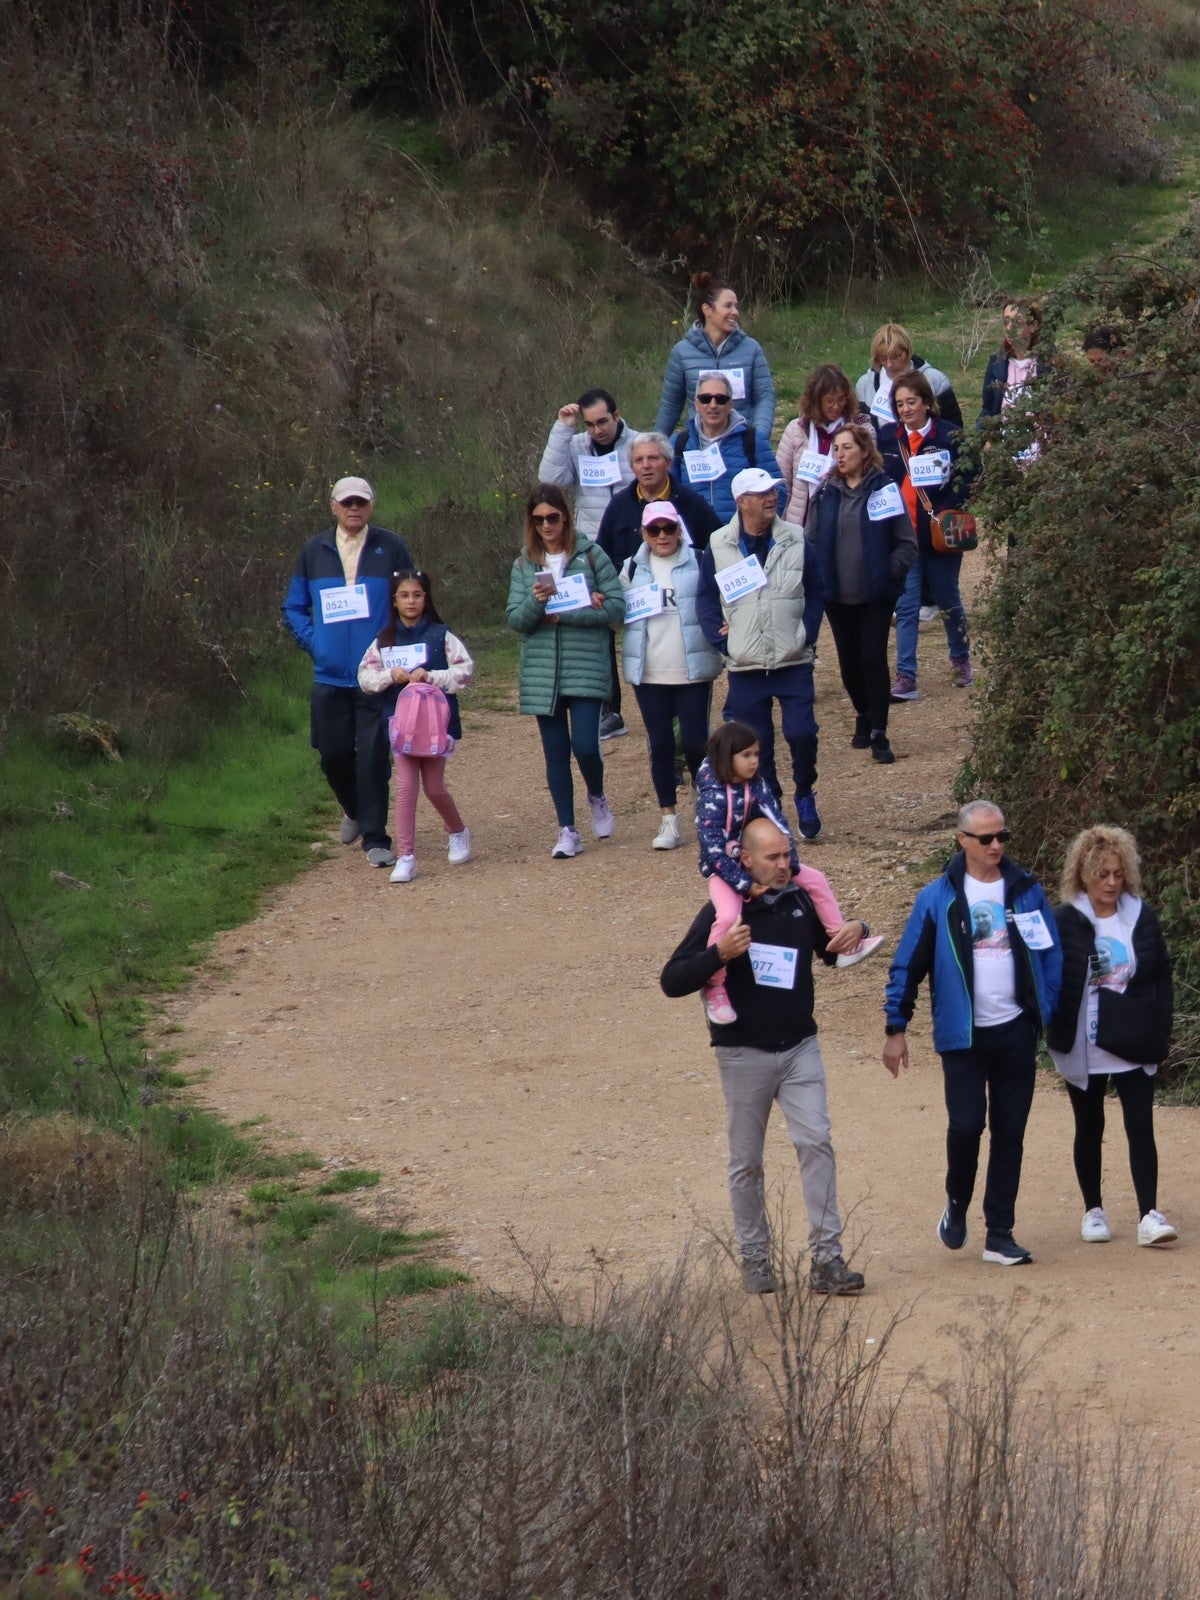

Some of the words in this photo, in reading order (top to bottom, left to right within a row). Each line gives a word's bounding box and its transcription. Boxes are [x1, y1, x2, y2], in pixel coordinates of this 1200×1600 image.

[690, 463, 711, 472] 0286
[799, 460, 822, 473] 0475
[913, 464, 936, 475] 0287
[583, 468, 606, 478] 0288
[724, 575, 748, 592] 0185
[325, 599, 349, 611] 0521
[627, 598, 646, 611] 0186
[385, 657, 408, 668] 0192
